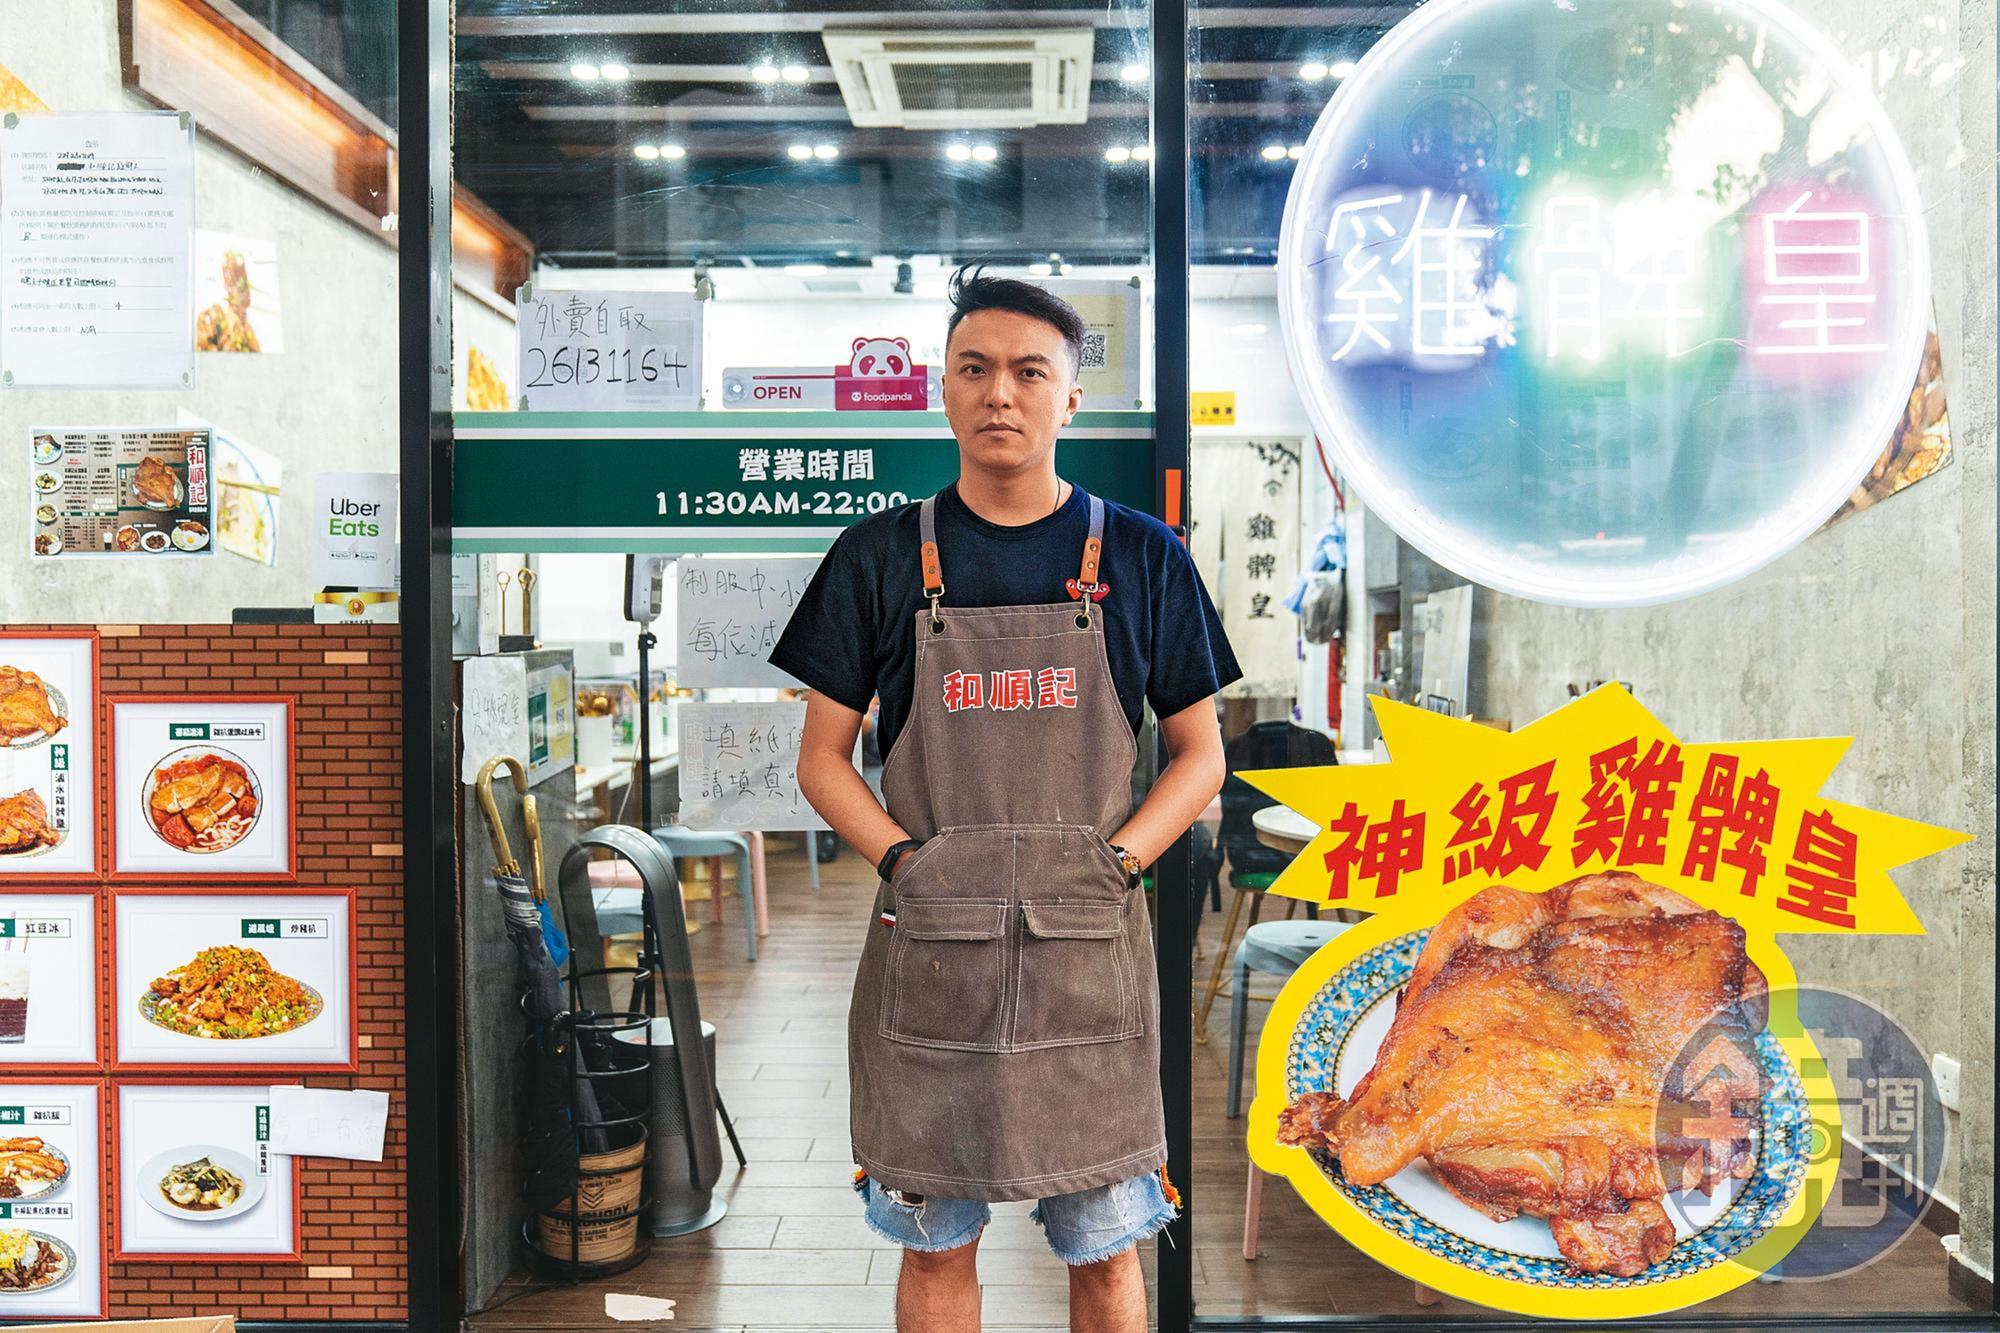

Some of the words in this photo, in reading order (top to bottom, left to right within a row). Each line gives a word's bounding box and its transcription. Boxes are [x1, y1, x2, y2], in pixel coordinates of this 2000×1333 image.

[1326, 190, 1889, 361] 雞髀皇
[535, 295, 652, 341] 外賣自取
[526, 346, 688, 388] 26131164
[753, 386, 801, 399] OPEN
[864, 391, 913, 403] foodpanda
[187, 446, 207, 506] 和順記
[737, 448, 875, 482] 營業時間
[330, 498, 381, 517] Uber
[656, 491, 924, 515] 11:30AM-22:00
[329, 518, 379, 537] Eats
[1247, 513, 1276, 620] 雞髀皇
[681, 567, 811, 610] 制服中、小
[943, 666, 1078, 712] 和順記
[1323, 735, 1861, 930] 神級雞髀皇
[25, 922, 60, 934] 紅豆冰
